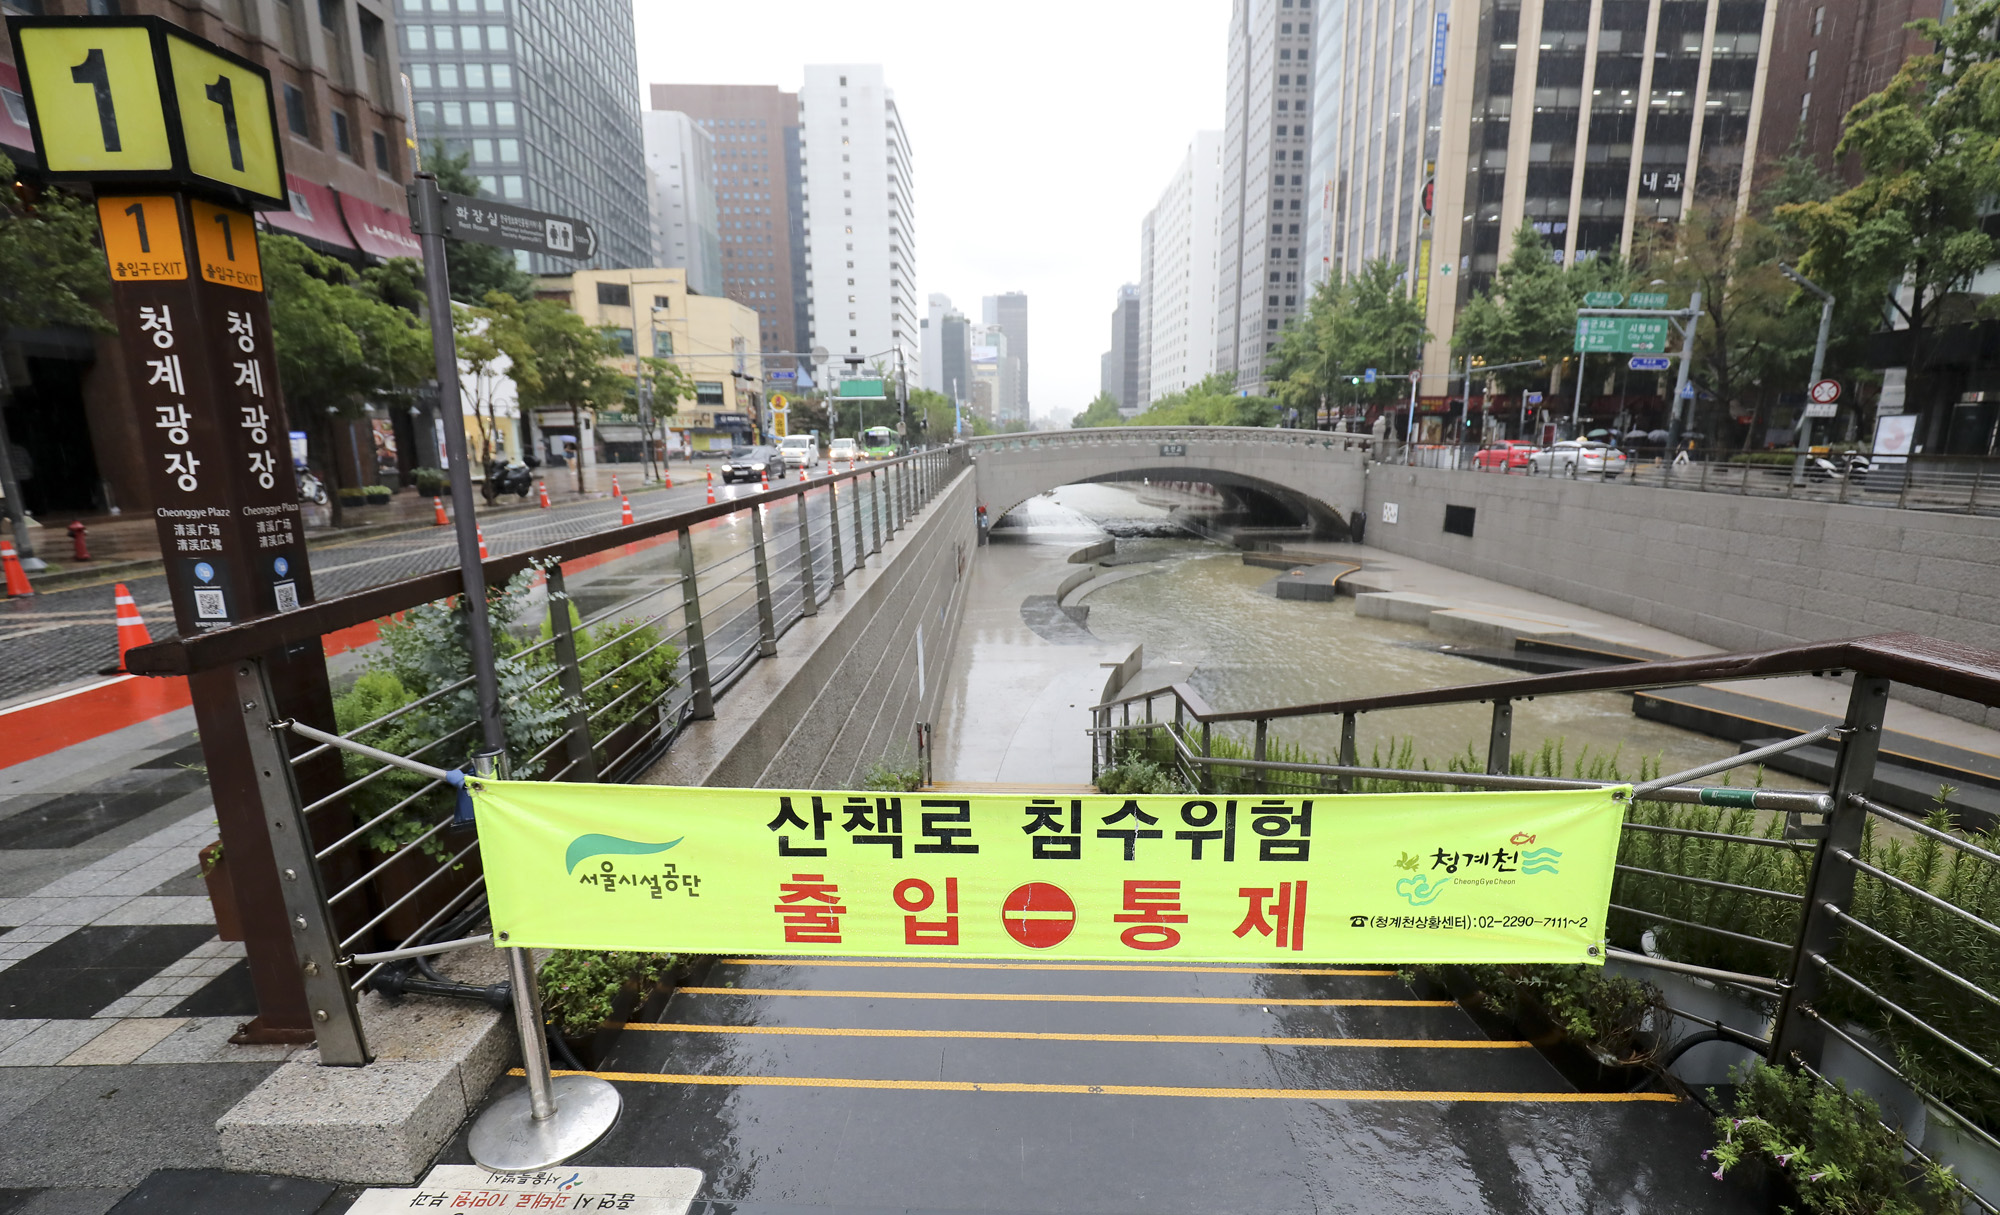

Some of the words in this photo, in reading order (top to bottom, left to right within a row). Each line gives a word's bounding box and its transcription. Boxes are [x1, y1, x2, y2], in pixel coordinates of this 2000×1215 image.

[70, 48, 122, 152] 1
[205, 74, 245, 173] 1
[1642, 172, 1681, 192] 내과
[124, 203, 151, 253] 1
[456, 206, 498, 227] 화장실
[214, 213, 235, 261] 1
[115, 261, 151, 276] 출입구
[153, 262, 182, 276] EXIT
[205, 264, 236, 280] 출입구
[237, 271, 259, 287] EXIT
[139, 304, 200, 492] 청계광장
[227, 310, 276, 490] 청계광장
[157, 507, 207, 519] Cheonggye
[242, 505, 282, 516] Cheonggye
[281, 502, 299, 512] Plaza
[766, 796, 979, 859] 산책로
[1021, 799, 1314, 862] 침수위험
[1429, 847, 1518, 873] 청계천
[579, 861, 702, 899] 서울시설공단
[486, 1171, 561, 1187] 서울특별시
[409, 1191, 448, 1208] 부과
[450, 1191, 506, 1209] 10만원
[515, 1192, 571, 1210] 과태료
